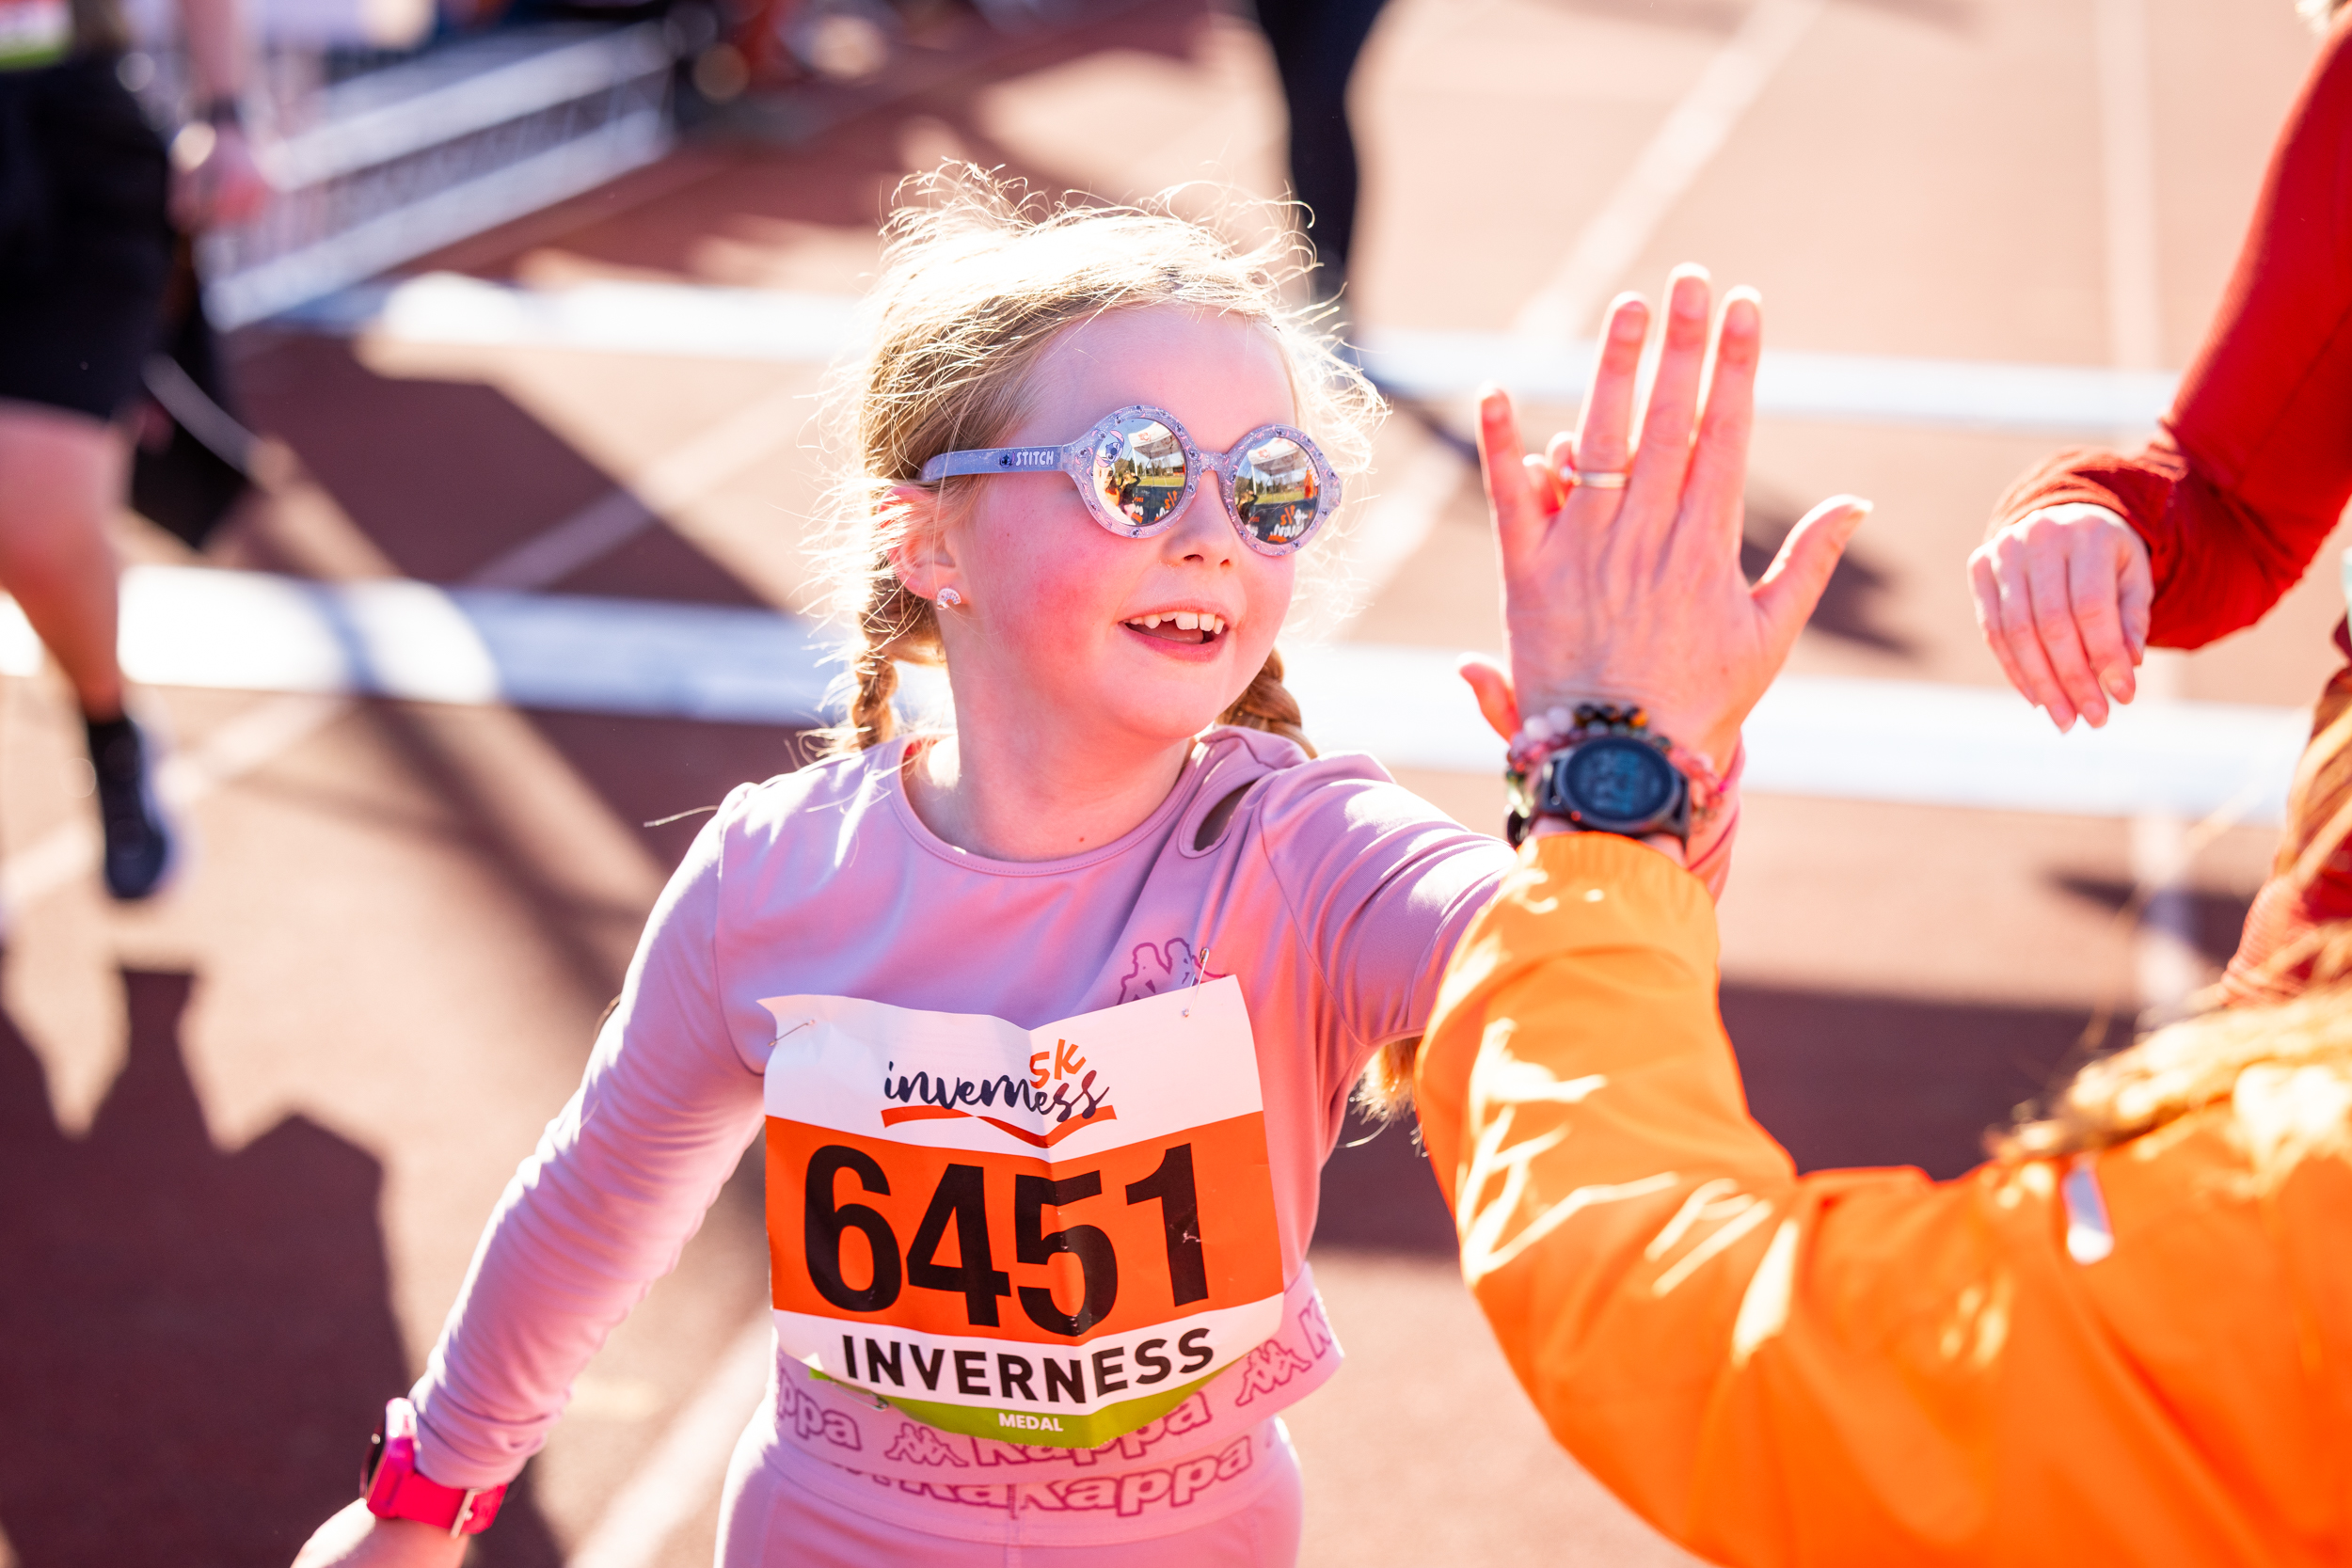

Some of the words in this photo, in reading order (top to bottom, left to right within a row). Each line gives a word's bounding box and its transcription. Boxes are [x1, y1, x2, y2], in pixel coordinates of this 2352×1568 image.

[1016, 451, 1054, 467] STITCH
[883, 1060, 1110, 1123] inverness
[803, 1143, 1210, 1338] 6451
[841, 1327, 1216, 1405] INVERNESS
[998, 1413, 1064, 1433] MEDAL
